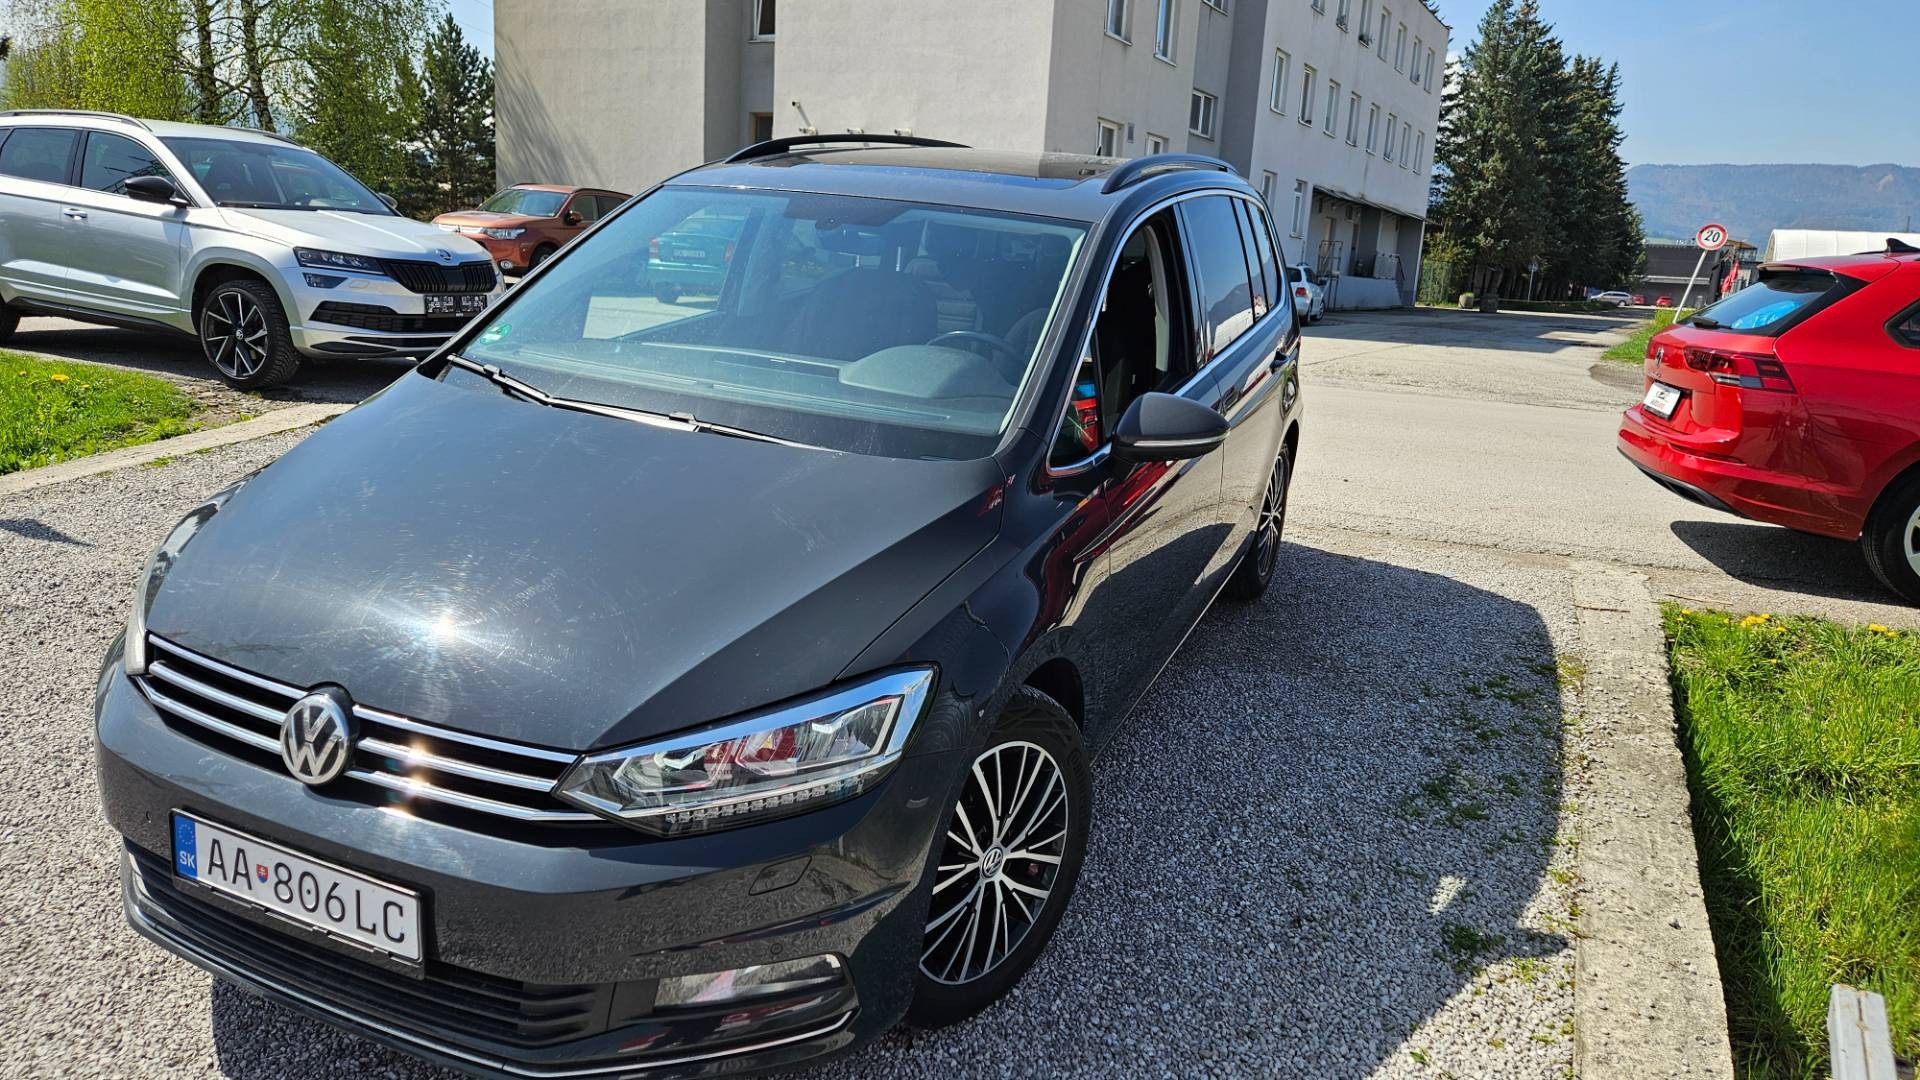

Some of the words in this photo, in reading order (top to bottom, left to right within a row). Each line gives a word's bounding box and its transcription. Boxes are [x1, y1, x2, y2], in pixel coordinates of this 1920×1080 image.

[1704, 229, 1721, 243] 20
[281, 694, 347, 783] VW
[179, 850, 196, 869] SK
